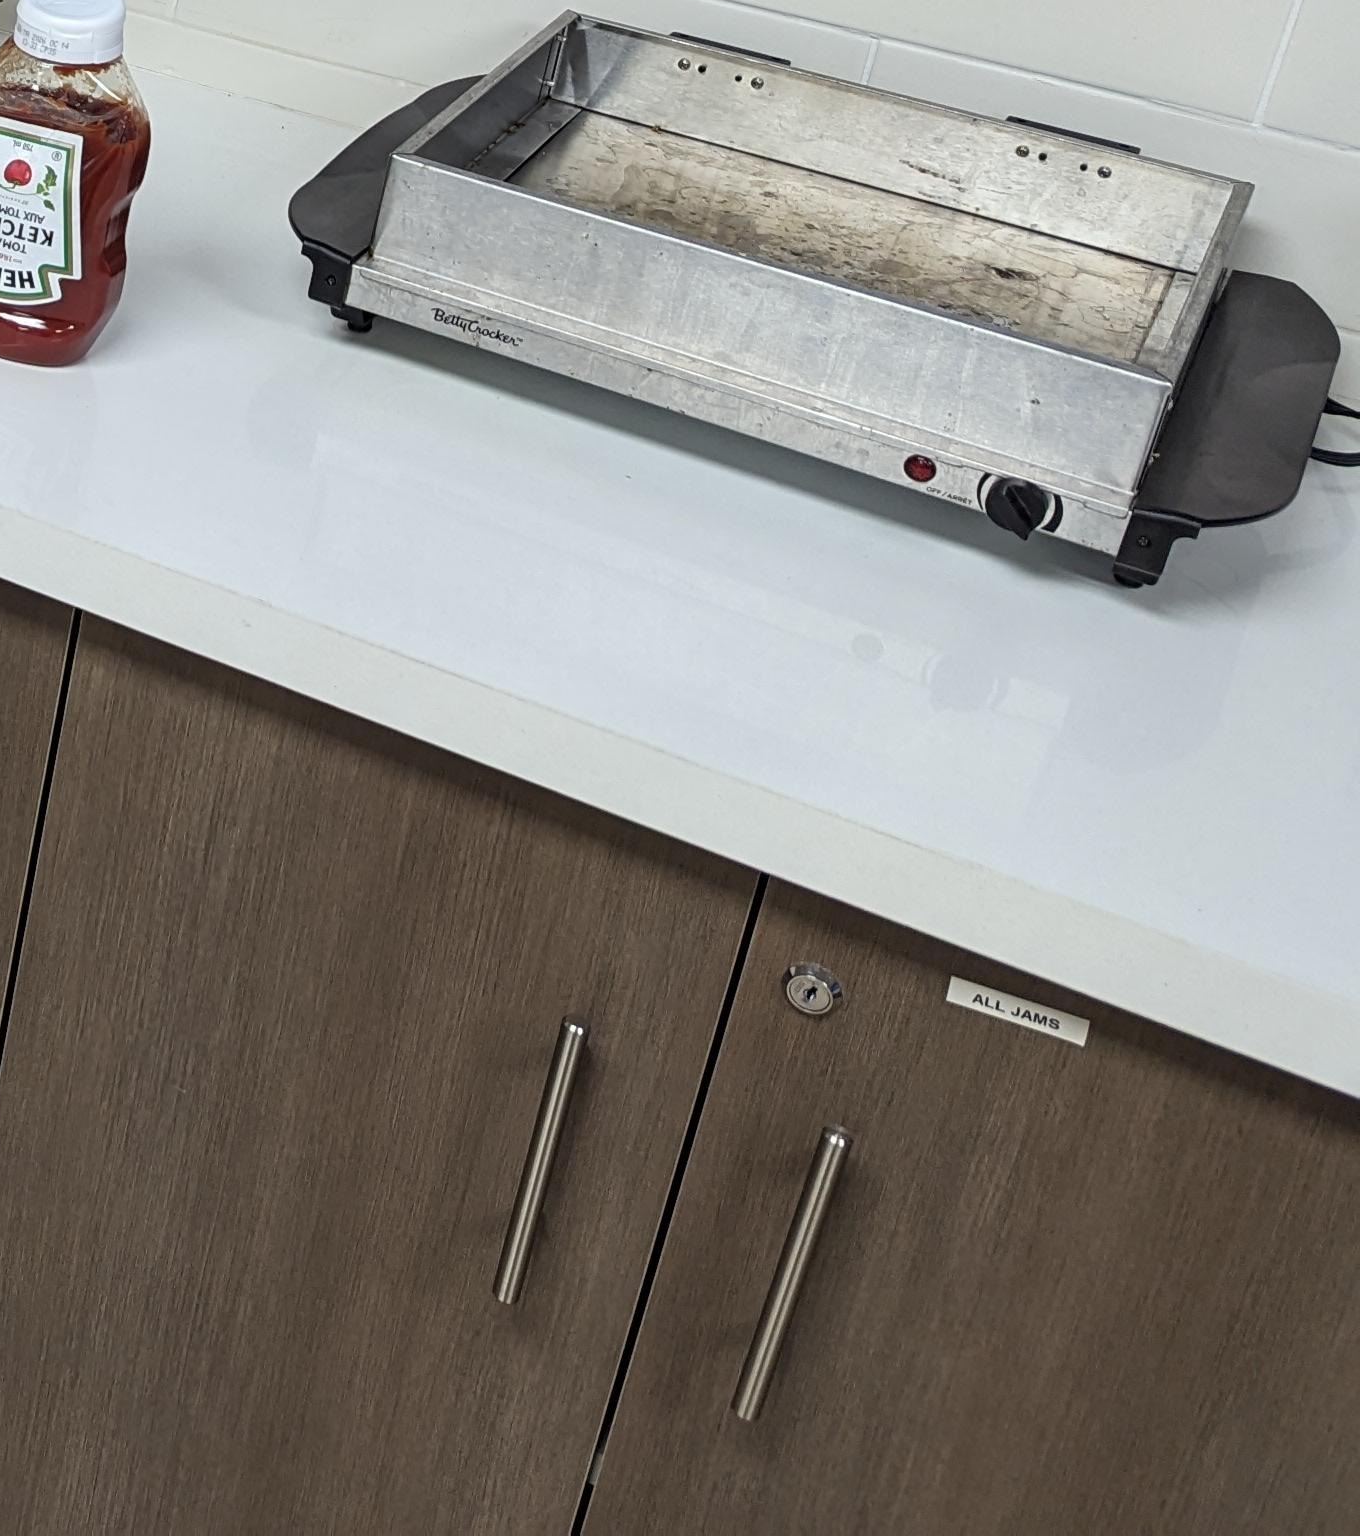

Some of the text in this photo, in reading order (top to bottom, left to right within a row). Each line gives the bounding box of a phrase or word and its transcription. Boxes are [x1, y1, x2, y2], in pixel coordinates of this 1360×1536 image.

[23, 210, 46, 224] AUX
[431, 307, 470, 333] Betty
[971, 992, 1060, 1031] ALL JAMS
